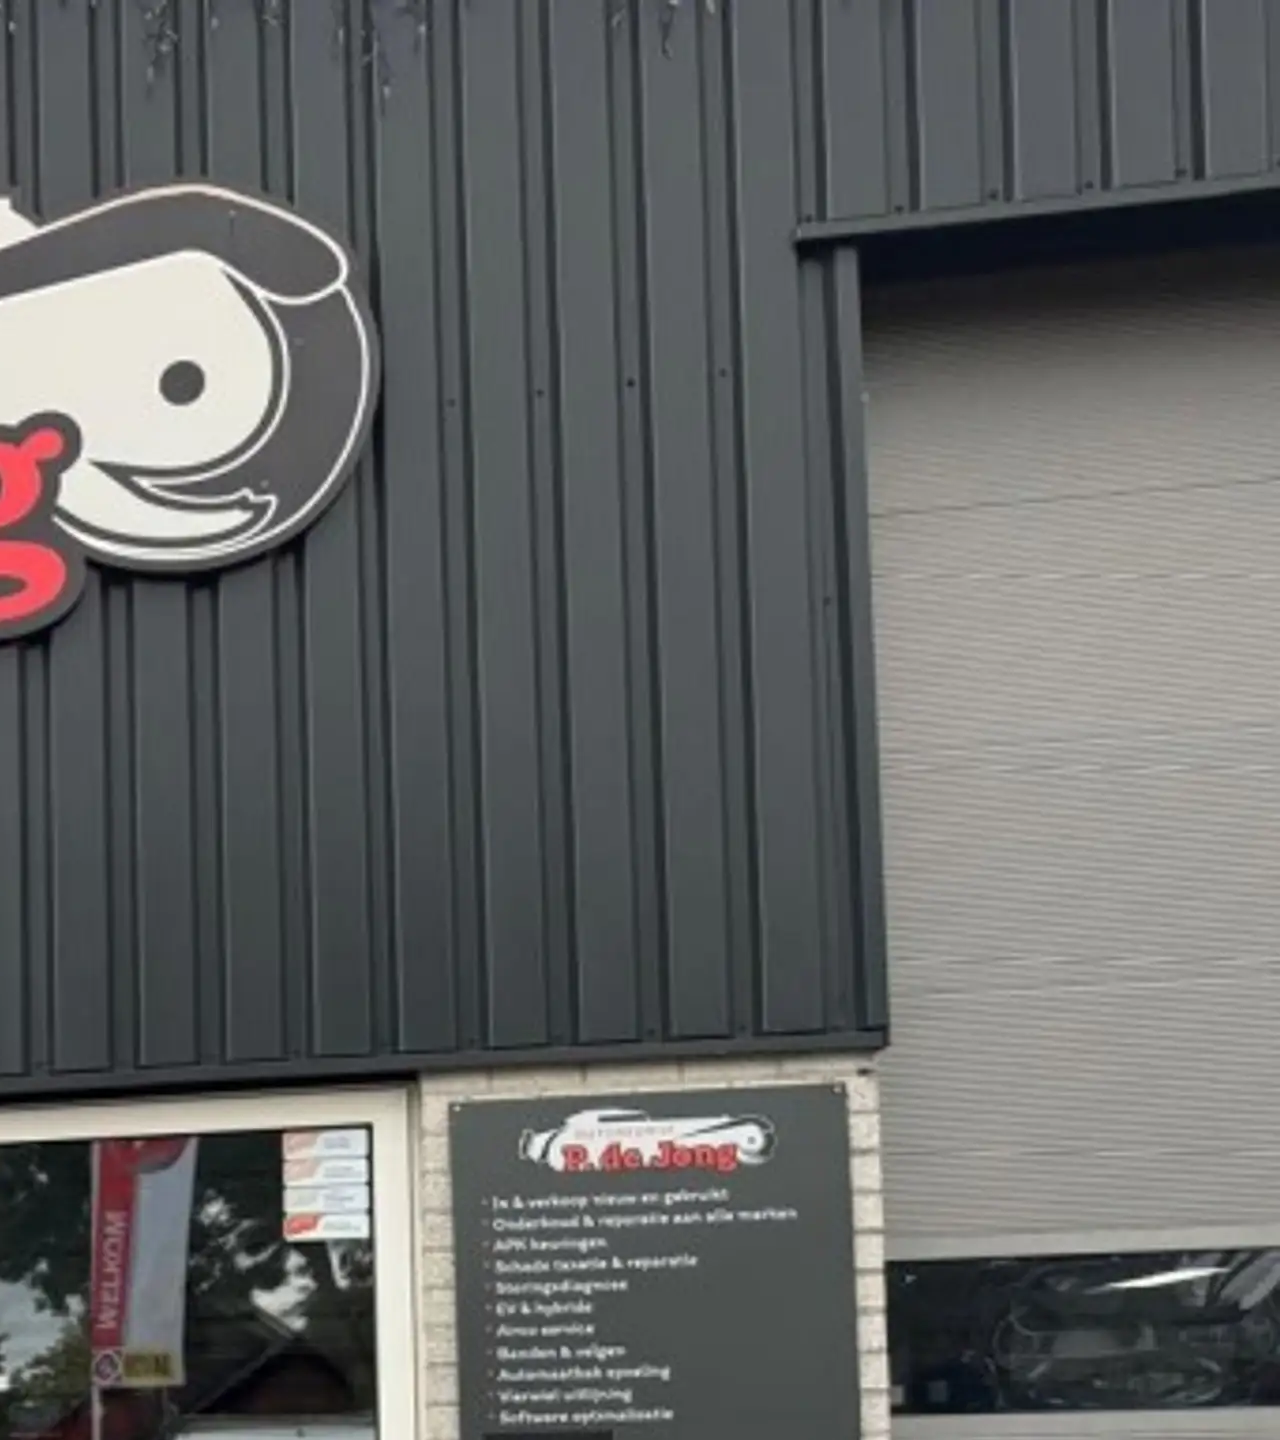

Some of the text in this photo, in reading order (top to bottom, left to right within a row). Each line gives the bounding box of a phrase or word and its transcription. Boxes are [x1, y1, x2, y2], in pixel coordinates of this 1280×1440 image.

[601, 1140, 641, 1169] de
[651, 1139, 738, 1172] Jong
[96, 1209, 128, 1330] WELKOM
